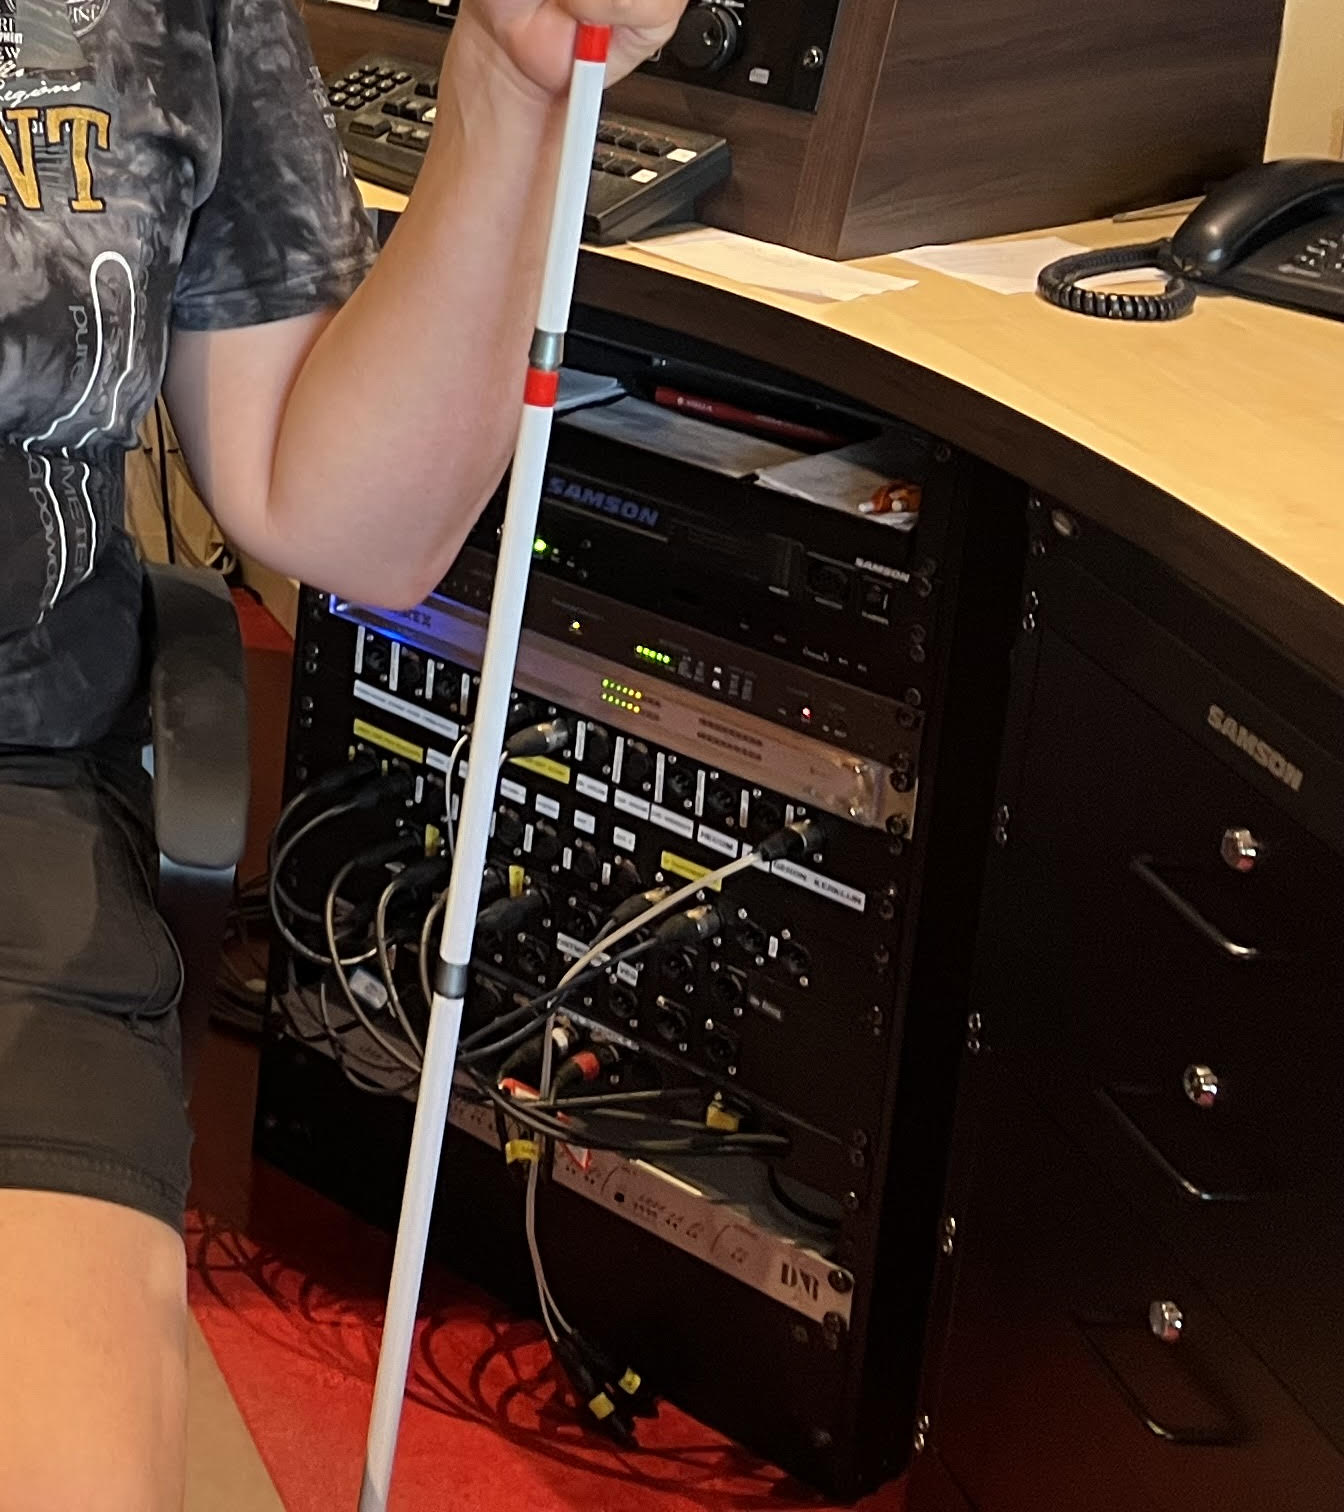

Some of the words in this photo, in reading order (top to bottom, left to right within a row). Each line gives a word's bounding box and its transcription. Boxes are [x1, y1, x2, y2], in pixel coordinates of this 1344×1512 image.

[546, 476, 660, 528] SAMSON
[854, 556, 911, 584] SAMSON
[1207, 704, 1304, 792] SAMSON
